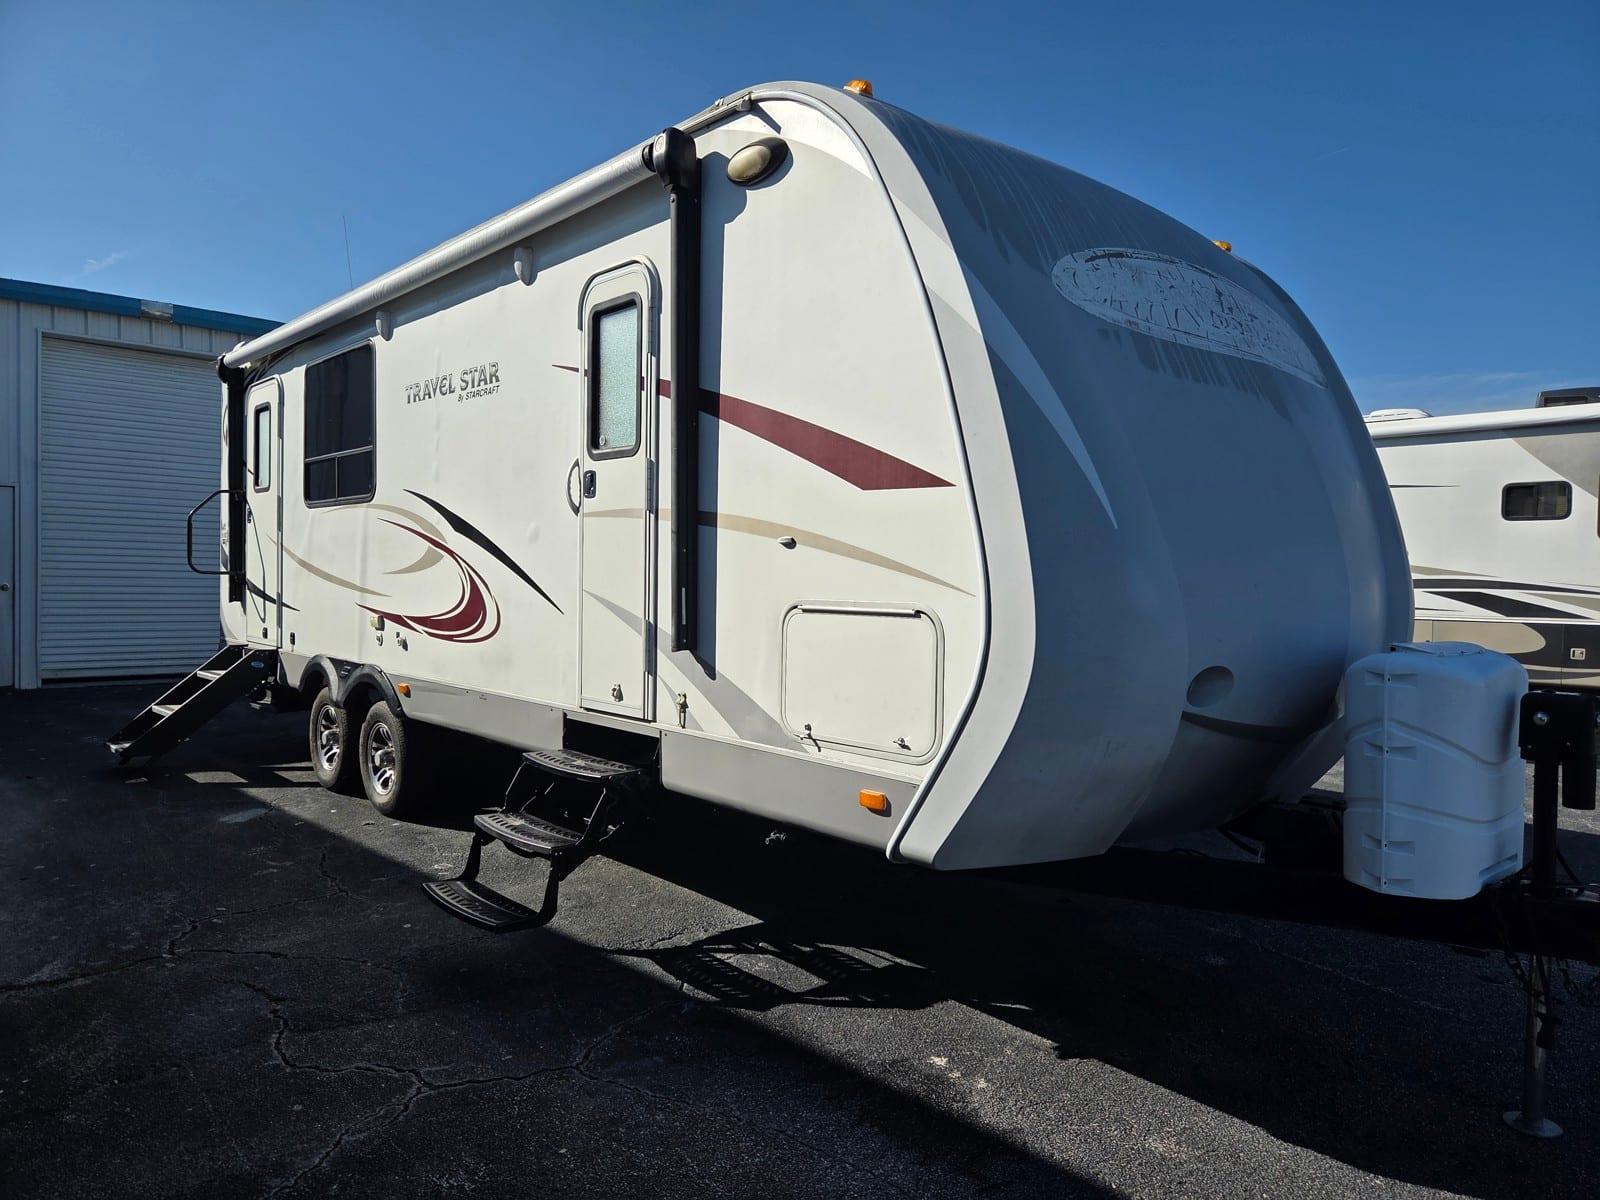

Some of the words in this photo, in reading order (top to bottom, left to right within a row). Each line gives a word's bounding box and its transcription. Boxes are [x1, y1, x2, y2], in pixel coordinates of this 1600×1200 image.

[405, 373, 456, 404] TRAVEL
[459, 361, 500, 391] STAR
[465, 385, 500, 400] STARCRAFT
